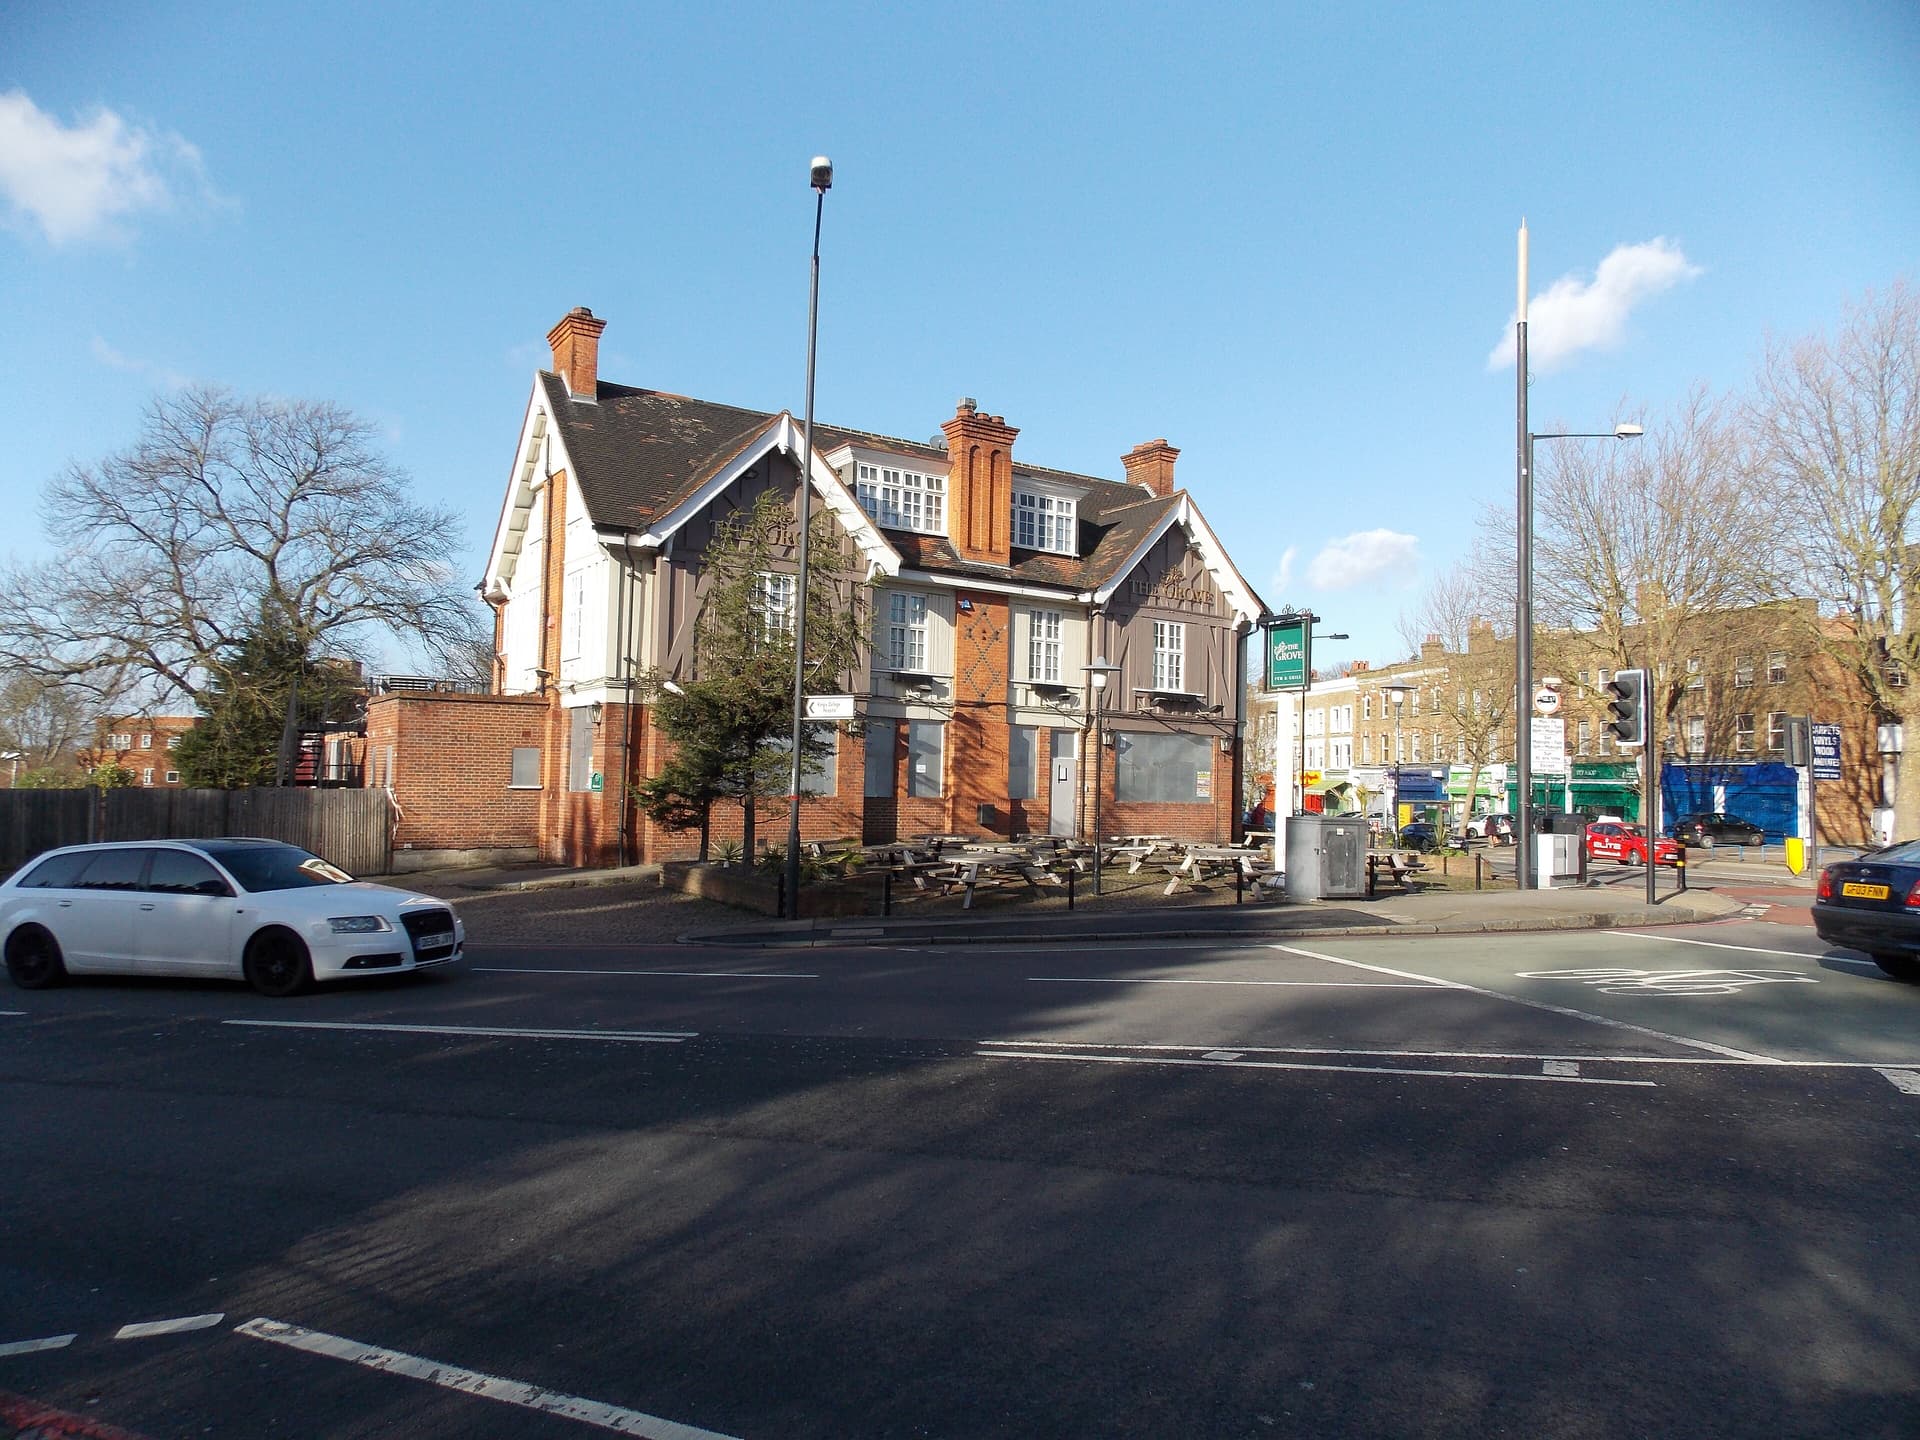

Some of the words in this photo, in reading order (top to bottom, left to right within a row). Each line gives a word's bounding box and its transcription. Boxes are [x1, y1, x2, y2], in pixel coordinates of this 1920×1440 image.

[1128, 579, 1159, 597] THE
[1275, 651, 1304, 661] GROVE
[1812, 736, 1837, 745] VINYLS
[1814, 746, 1836, 756] WOOD
